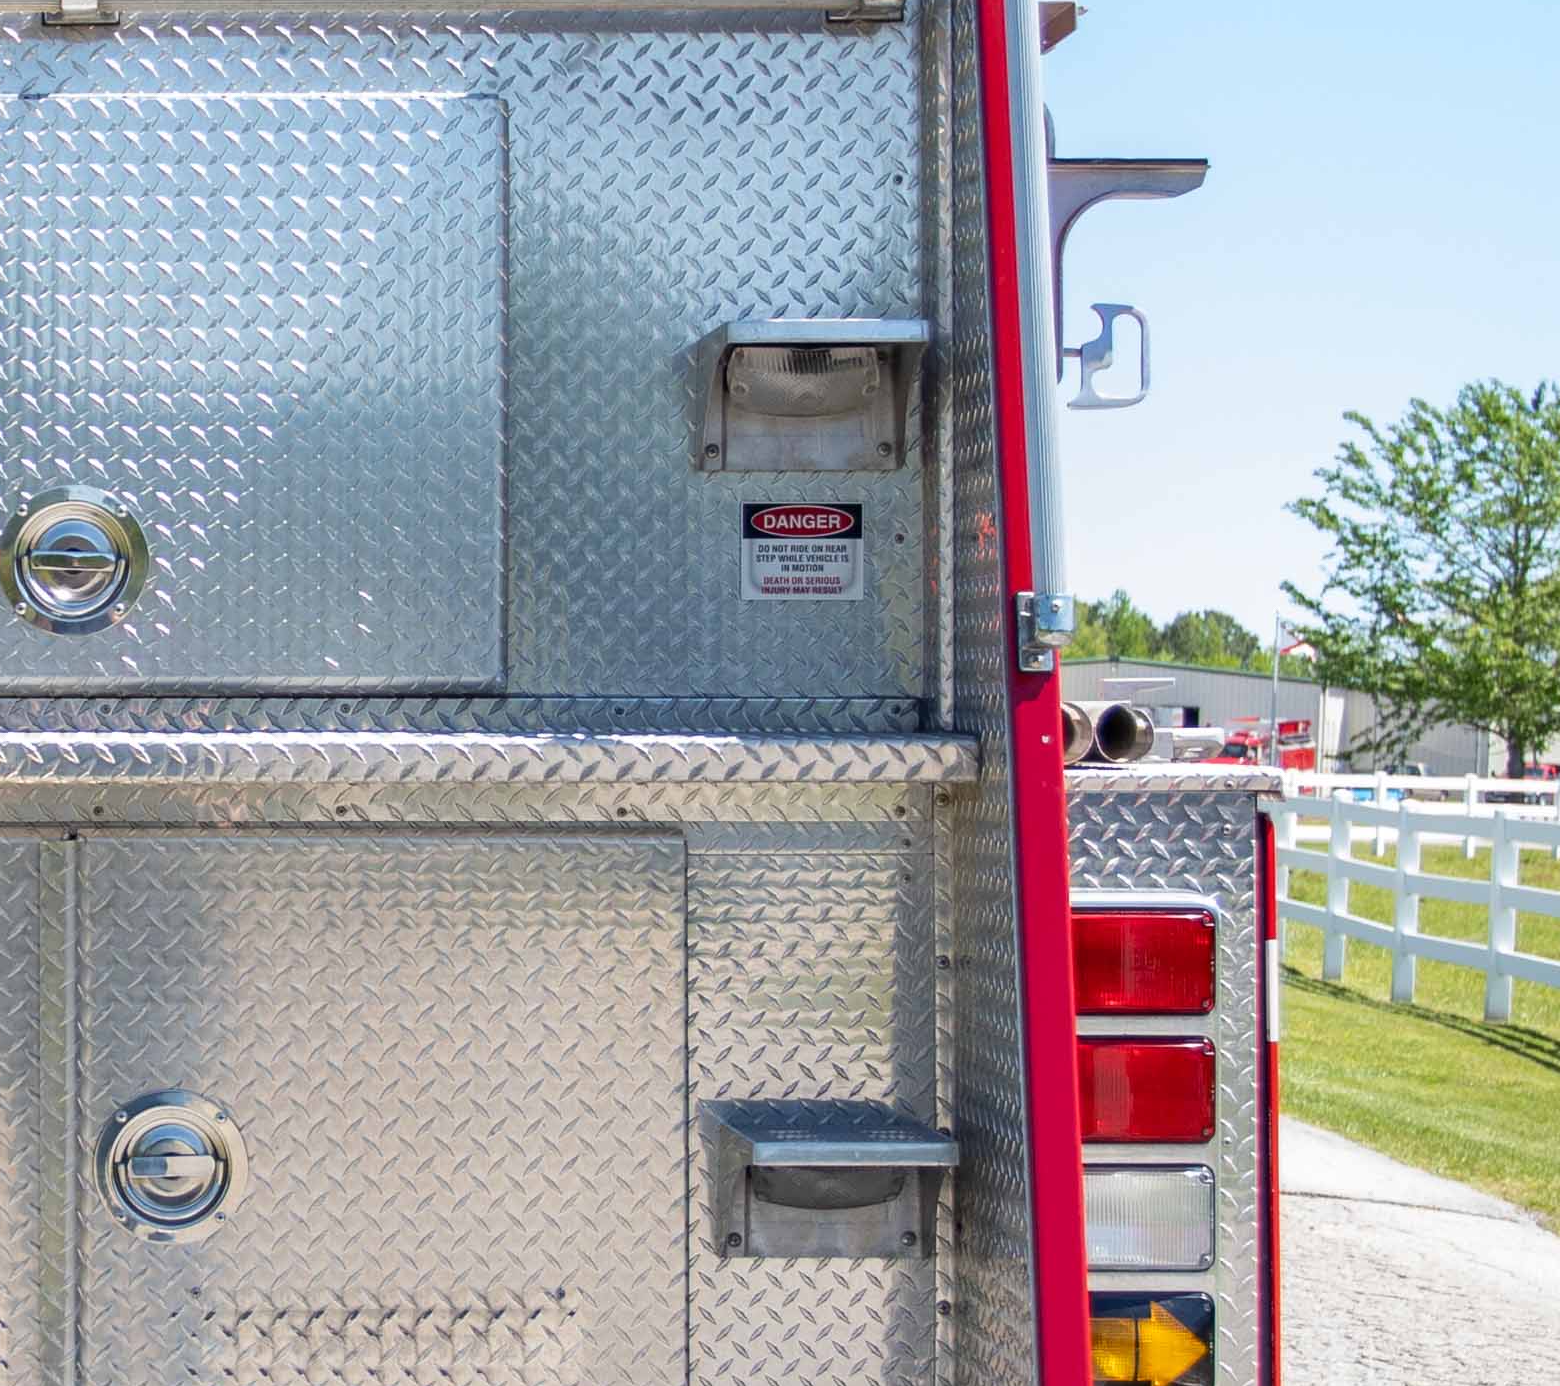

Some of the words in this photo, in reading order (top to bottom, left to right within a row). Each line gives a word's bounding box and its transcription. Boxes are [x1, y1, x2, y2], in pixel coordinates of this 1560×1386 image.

[763, 514, 842, 530] DANGER
[758, 544, 770, 553] DO
[772, 544, 788, 553] NOT
[790, 544, 809, 553] RIDE
[811, 544, 824, 553] ON
[825, 544, 847, 553] REAR
[756, 554, 776, 563] STEP
[777, 554, 805, 563] WHILE
[805, 554, 839, 563] VEHICLE
[841, 554, 849, 563] IS
[781, 564, 790, 573] IN
[792, 564, 824, 573] MOTION
[763, 576, 789, 585] DEATH
[791, 576, 803, 585] OR
[805, 576, 840, 585] SERIOUS
[761, 586, 790, 595] INJURY
[793, 586, 811, 595] MAY
[812, 586, 843, 595] RESULT
